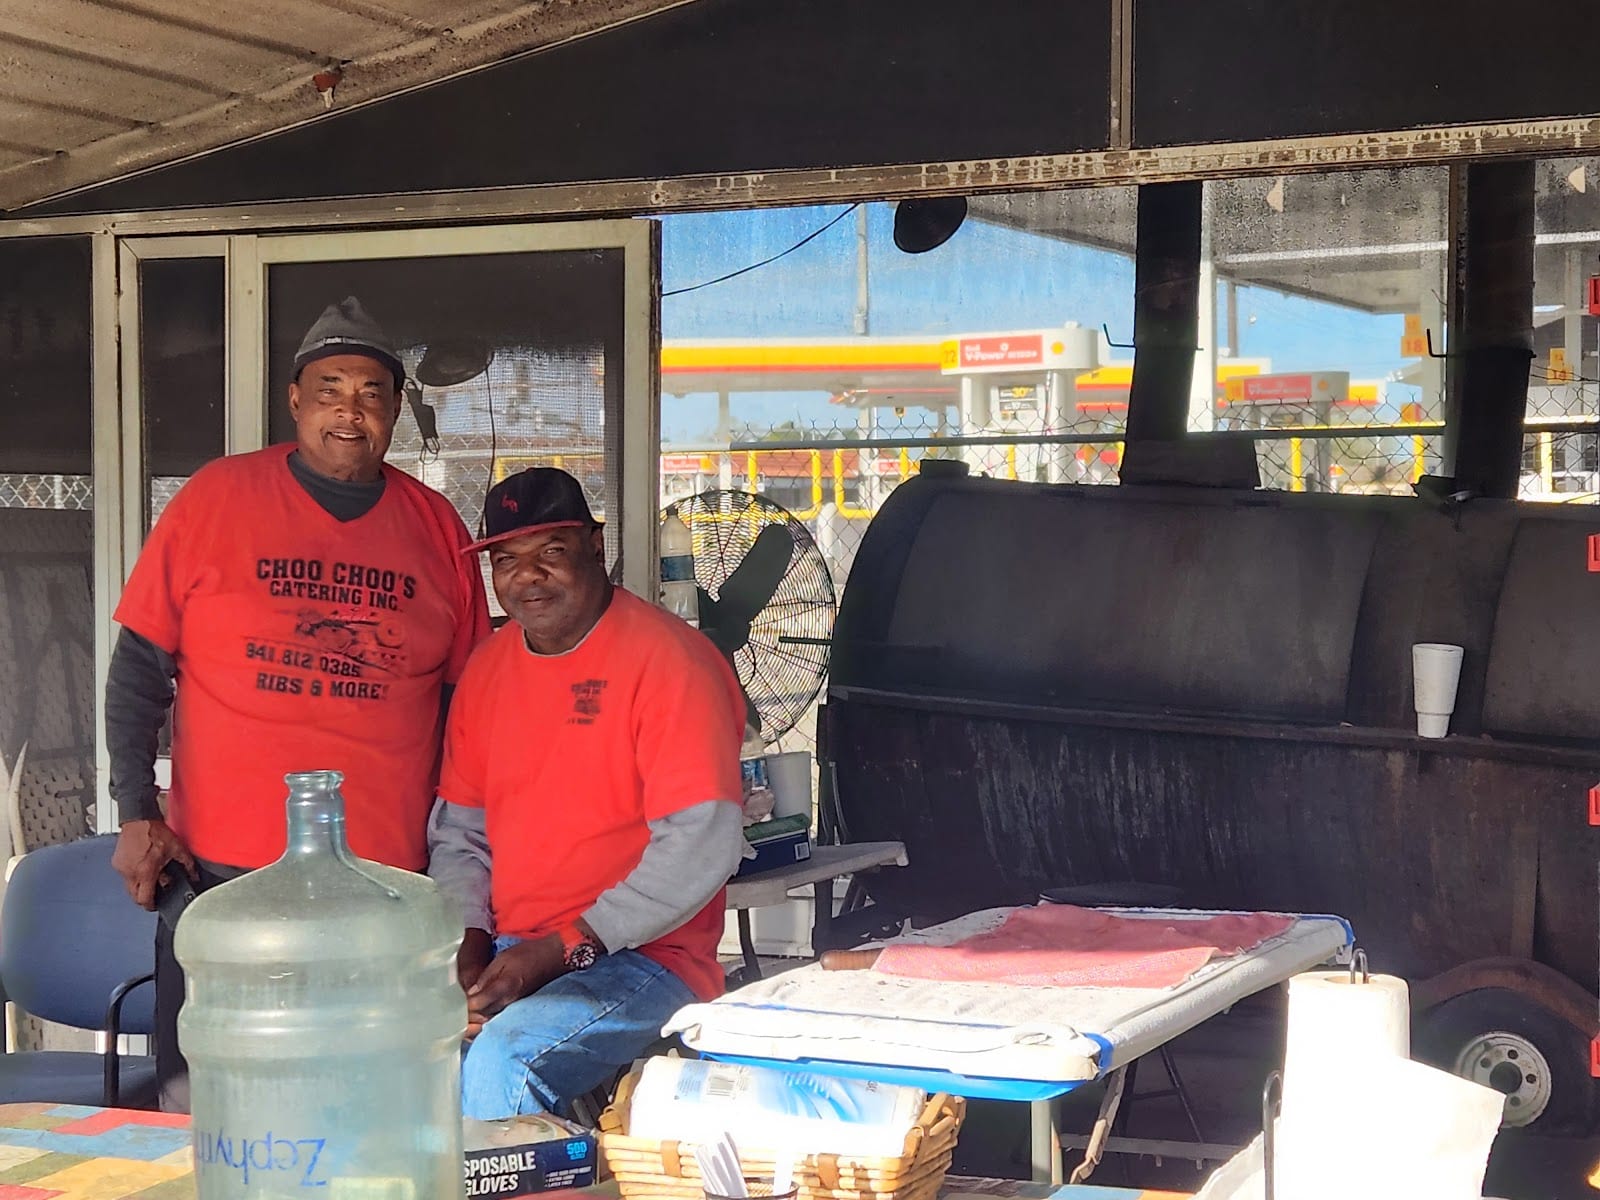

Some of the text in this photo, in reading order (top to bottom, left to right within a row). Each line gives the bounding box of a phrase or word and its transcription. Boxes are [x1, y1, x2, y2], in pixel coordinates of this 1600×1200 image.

[257, 559, 416, 599] CHOO CHOO'S
[270, 580, 362, 605] CATERING
[257, 672, 303, 694] RIBS
[311, 681, 322, 696] &
[567, 1141, 587, 1154] 500
[464, 1174, 518, 1196] GLOVES
